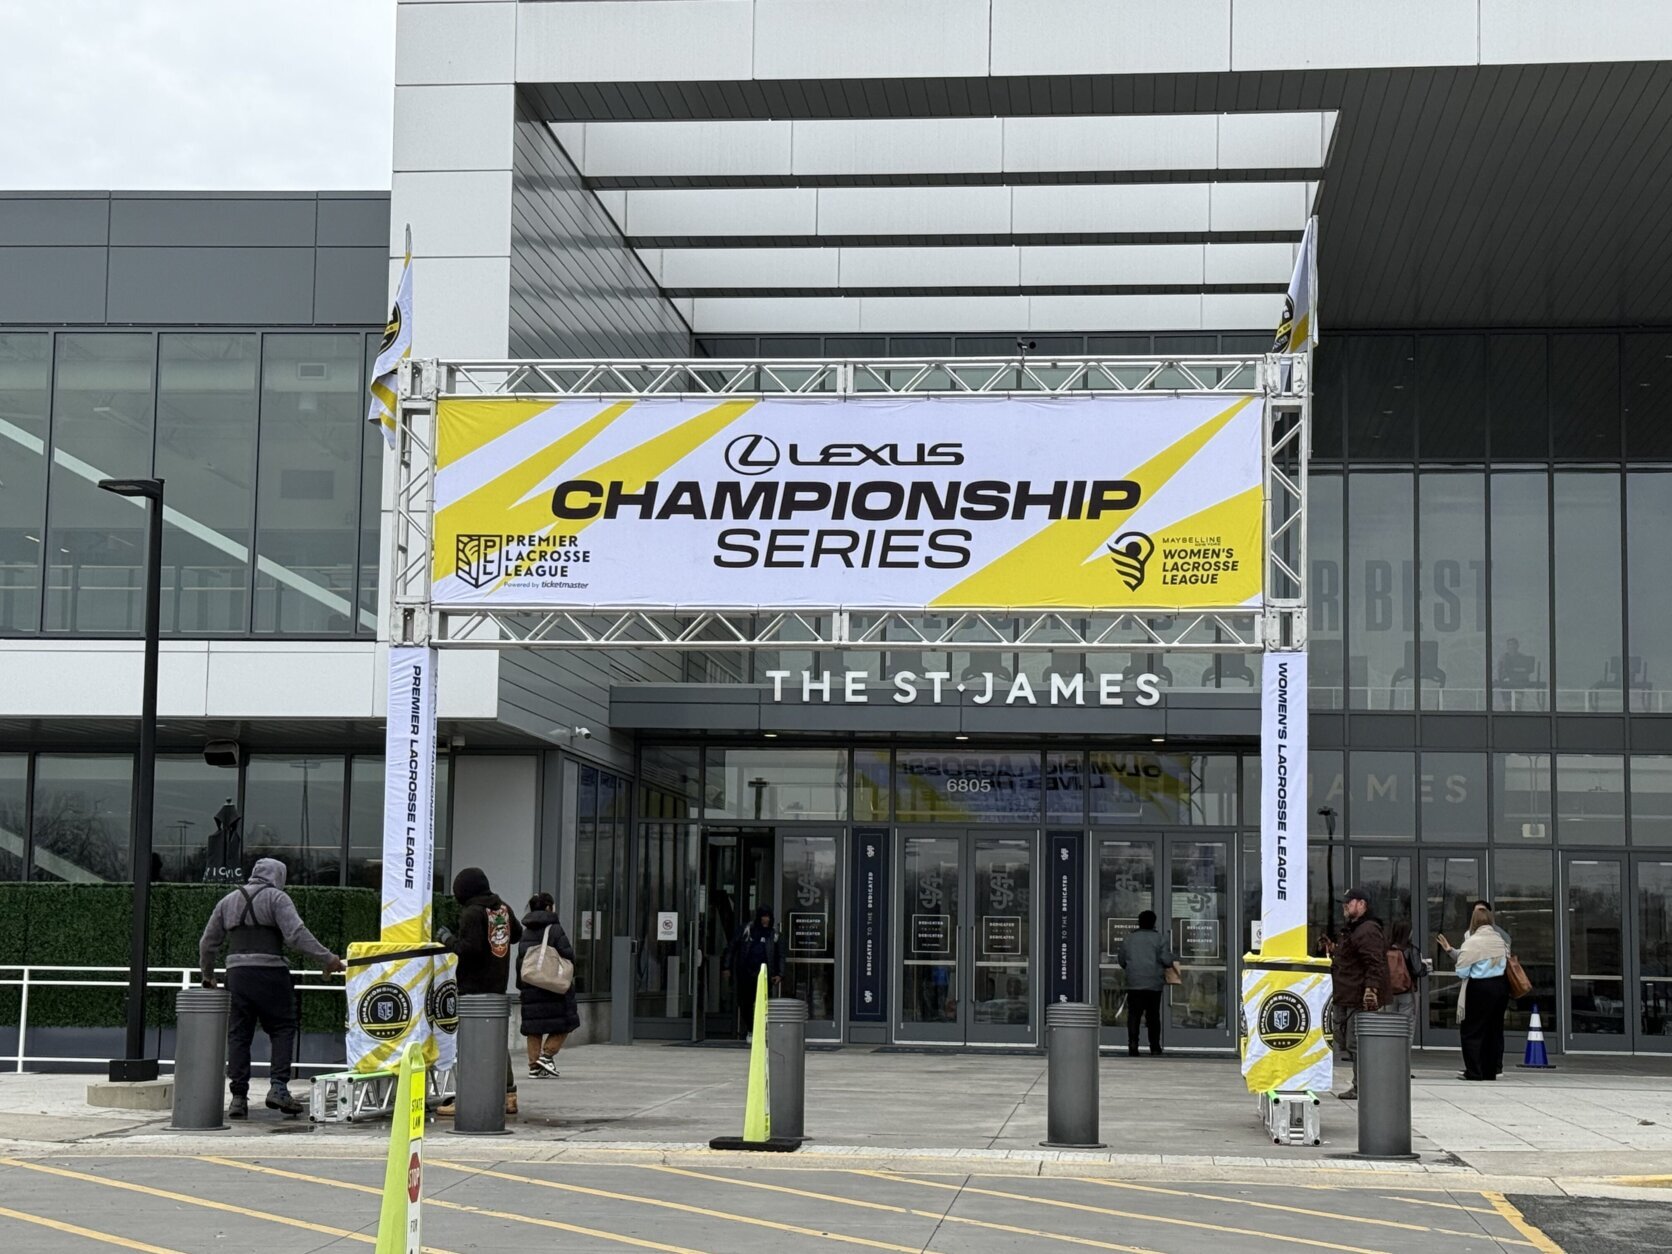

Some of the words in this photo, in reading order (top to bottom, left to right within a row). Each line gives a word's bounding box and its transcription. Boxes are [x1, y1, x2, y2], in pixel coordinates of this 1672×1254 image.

[789, 443, 964, 466] LEXUS
[551, 479, 1142, 521] CHAMPIONSHIP
[505, 534, 578, 548] PREMIER
[713, 528, 973, 570] SERIES
[1162, 536, 1222, 544] MAYBELLINE
[505, 549, 591, 563] LACROSSE
[1162, 548, 1234, 560] WOMEN'S
[504, 565, 569, 578] LEAGUE
[1162, 560, 1240, 573] LACROSSE
[531, 581, 540, 590] by
[541, 580, 589, 590] ticketmaster
[1162, 573, 1219, 585] LEAGUE
[1365, 560, 1494, 632] BEST
[765, 670, 869, 703] THE
[410, 664, 422, 735] PREMIER
[1277, 662, 1288, 740] WOMEN'S
[407, 738, 418, 823] LACROSSE
[946, 778, 991, 793] 6805
[1277, 744, 1288, 831] LACROSSE
[404, 826, 415, 889] LEAGUE
[1277, 835, 1287, 901] LEAGUE
[411, 1097, 424, 1113] STATE
[412, 1115, 421, 1131] LAW
[408, 1166, 421, 1190] STOP
